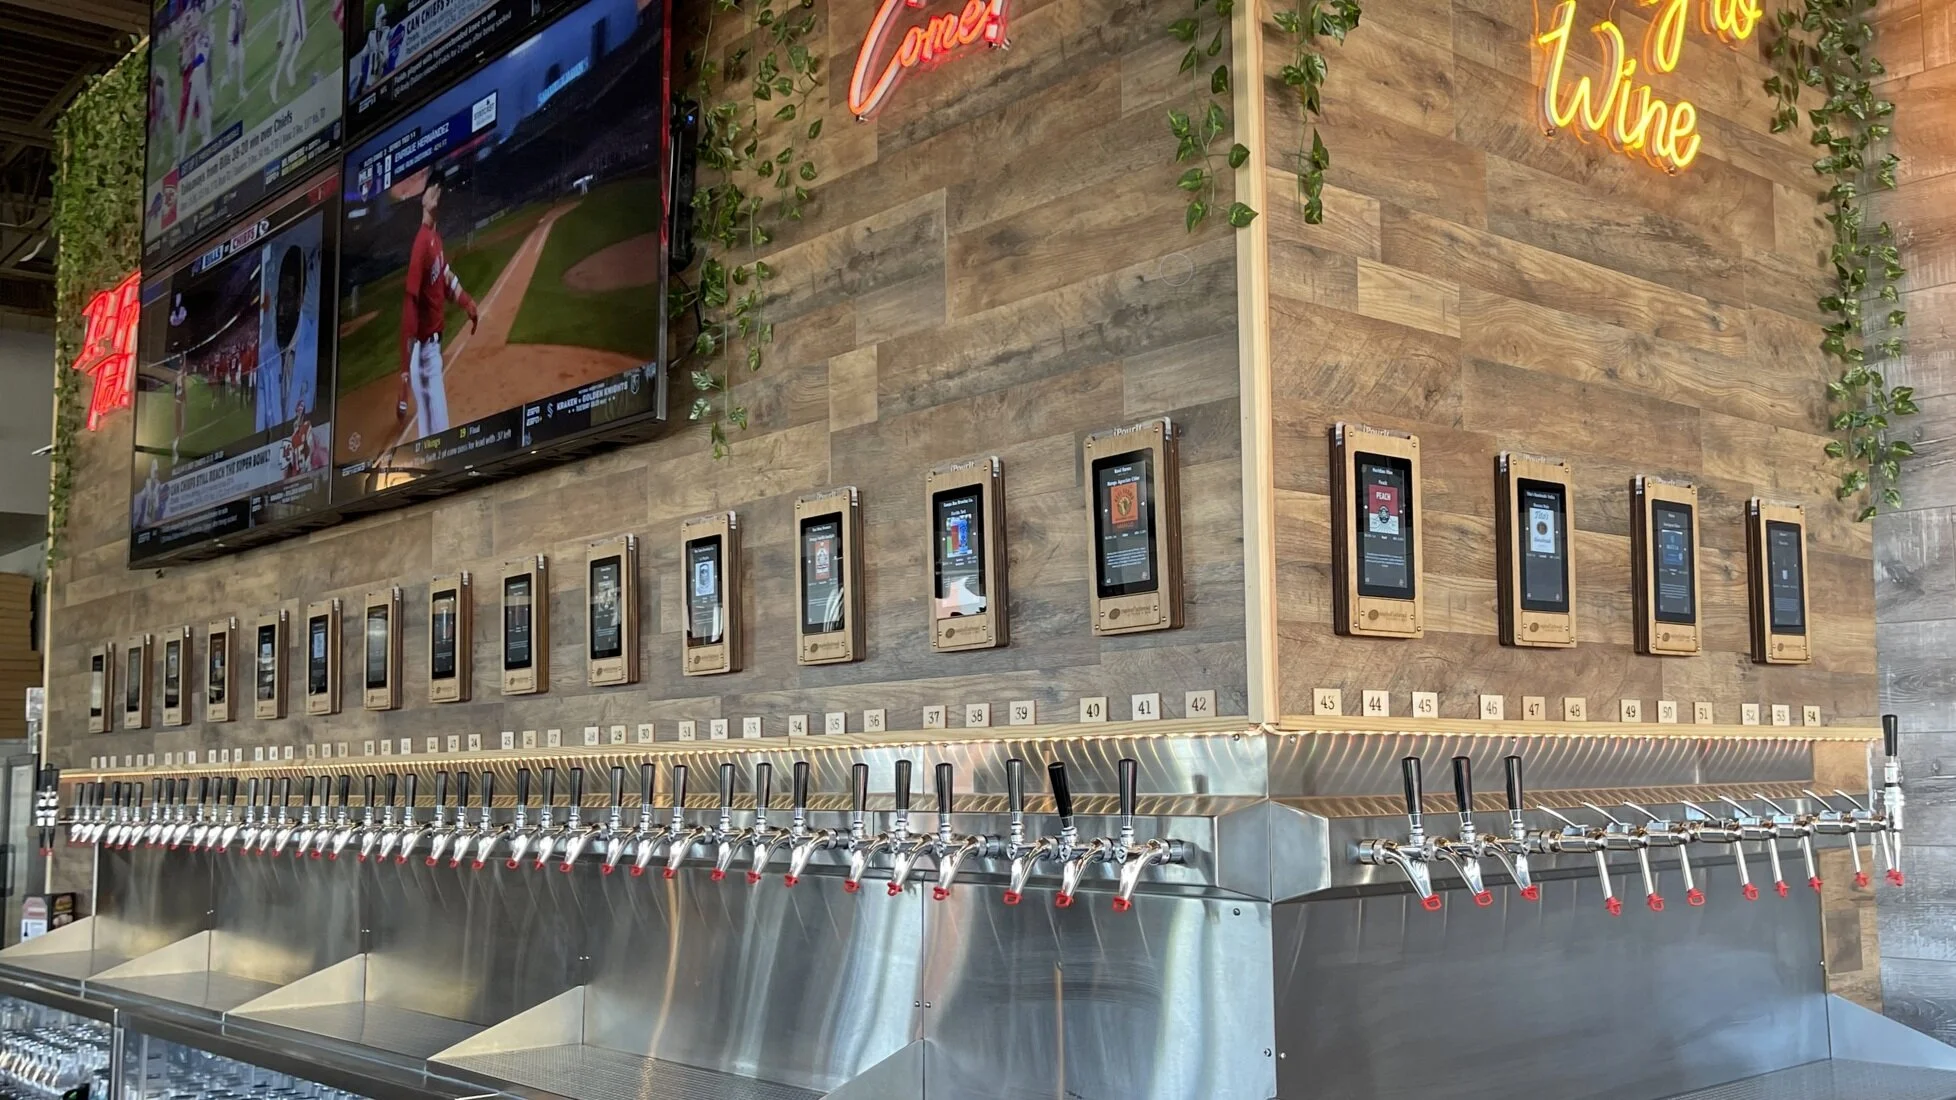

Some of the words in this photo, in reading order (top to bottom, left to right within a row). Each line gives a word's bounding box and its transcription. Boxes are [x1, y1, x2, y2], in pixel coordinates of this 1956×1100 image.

[849, 0, 1003, 115] Come!
[1537, 0, 1701, 168] Wine
[359, 92, 376, 113] ESPN
[233, 227, 255, 249] CHIEFS
[556, 397, 578, 411] KRAKEN
[582, 389, 603, 404] GOLDEN
[603, 381, 628, 397] KNIGHTS
[423, 438, 441, 450] Vikings
[469, 424, 480, 435] Final
[236, 456, 252, 472] SUPER
[1376, 491, 1391, 502] PEACH
[1138, 700, 1151, 715] 41
[1191, 697, 1207, 712] 42
[1320, 695, 1335, 709] 43
[1369, 697, 1382, 711] 44
[1418, 699, 1432, 713] 45
[1486, 701, 1498, 715] 46
[1015, 706, 1028, 720] 39
[1086, 703, 1100, 717] 40
[1528, 703, 1540, 716] 47
[1570, 705, 1581, 717] 48
[1625, 705, 1636, 718] 49
[1662, 706, 1672, 719] 50
[1699, 707, 1708, 720] 51
[1746, 709, 1755, 721] 52
[1777, 709, 1786, 721] 53
[1808, 710, 1816, 722] 54
[869, 715, 880, 727] 36
[928, 711, 940, 724] 37
[971, 710, 983, 723] 38
[715, 724, 723, 735] 32
[792, 720, 802, 732] 34
[830, 718, 840, 730] 35
[683, 726, 691, 737] 31
